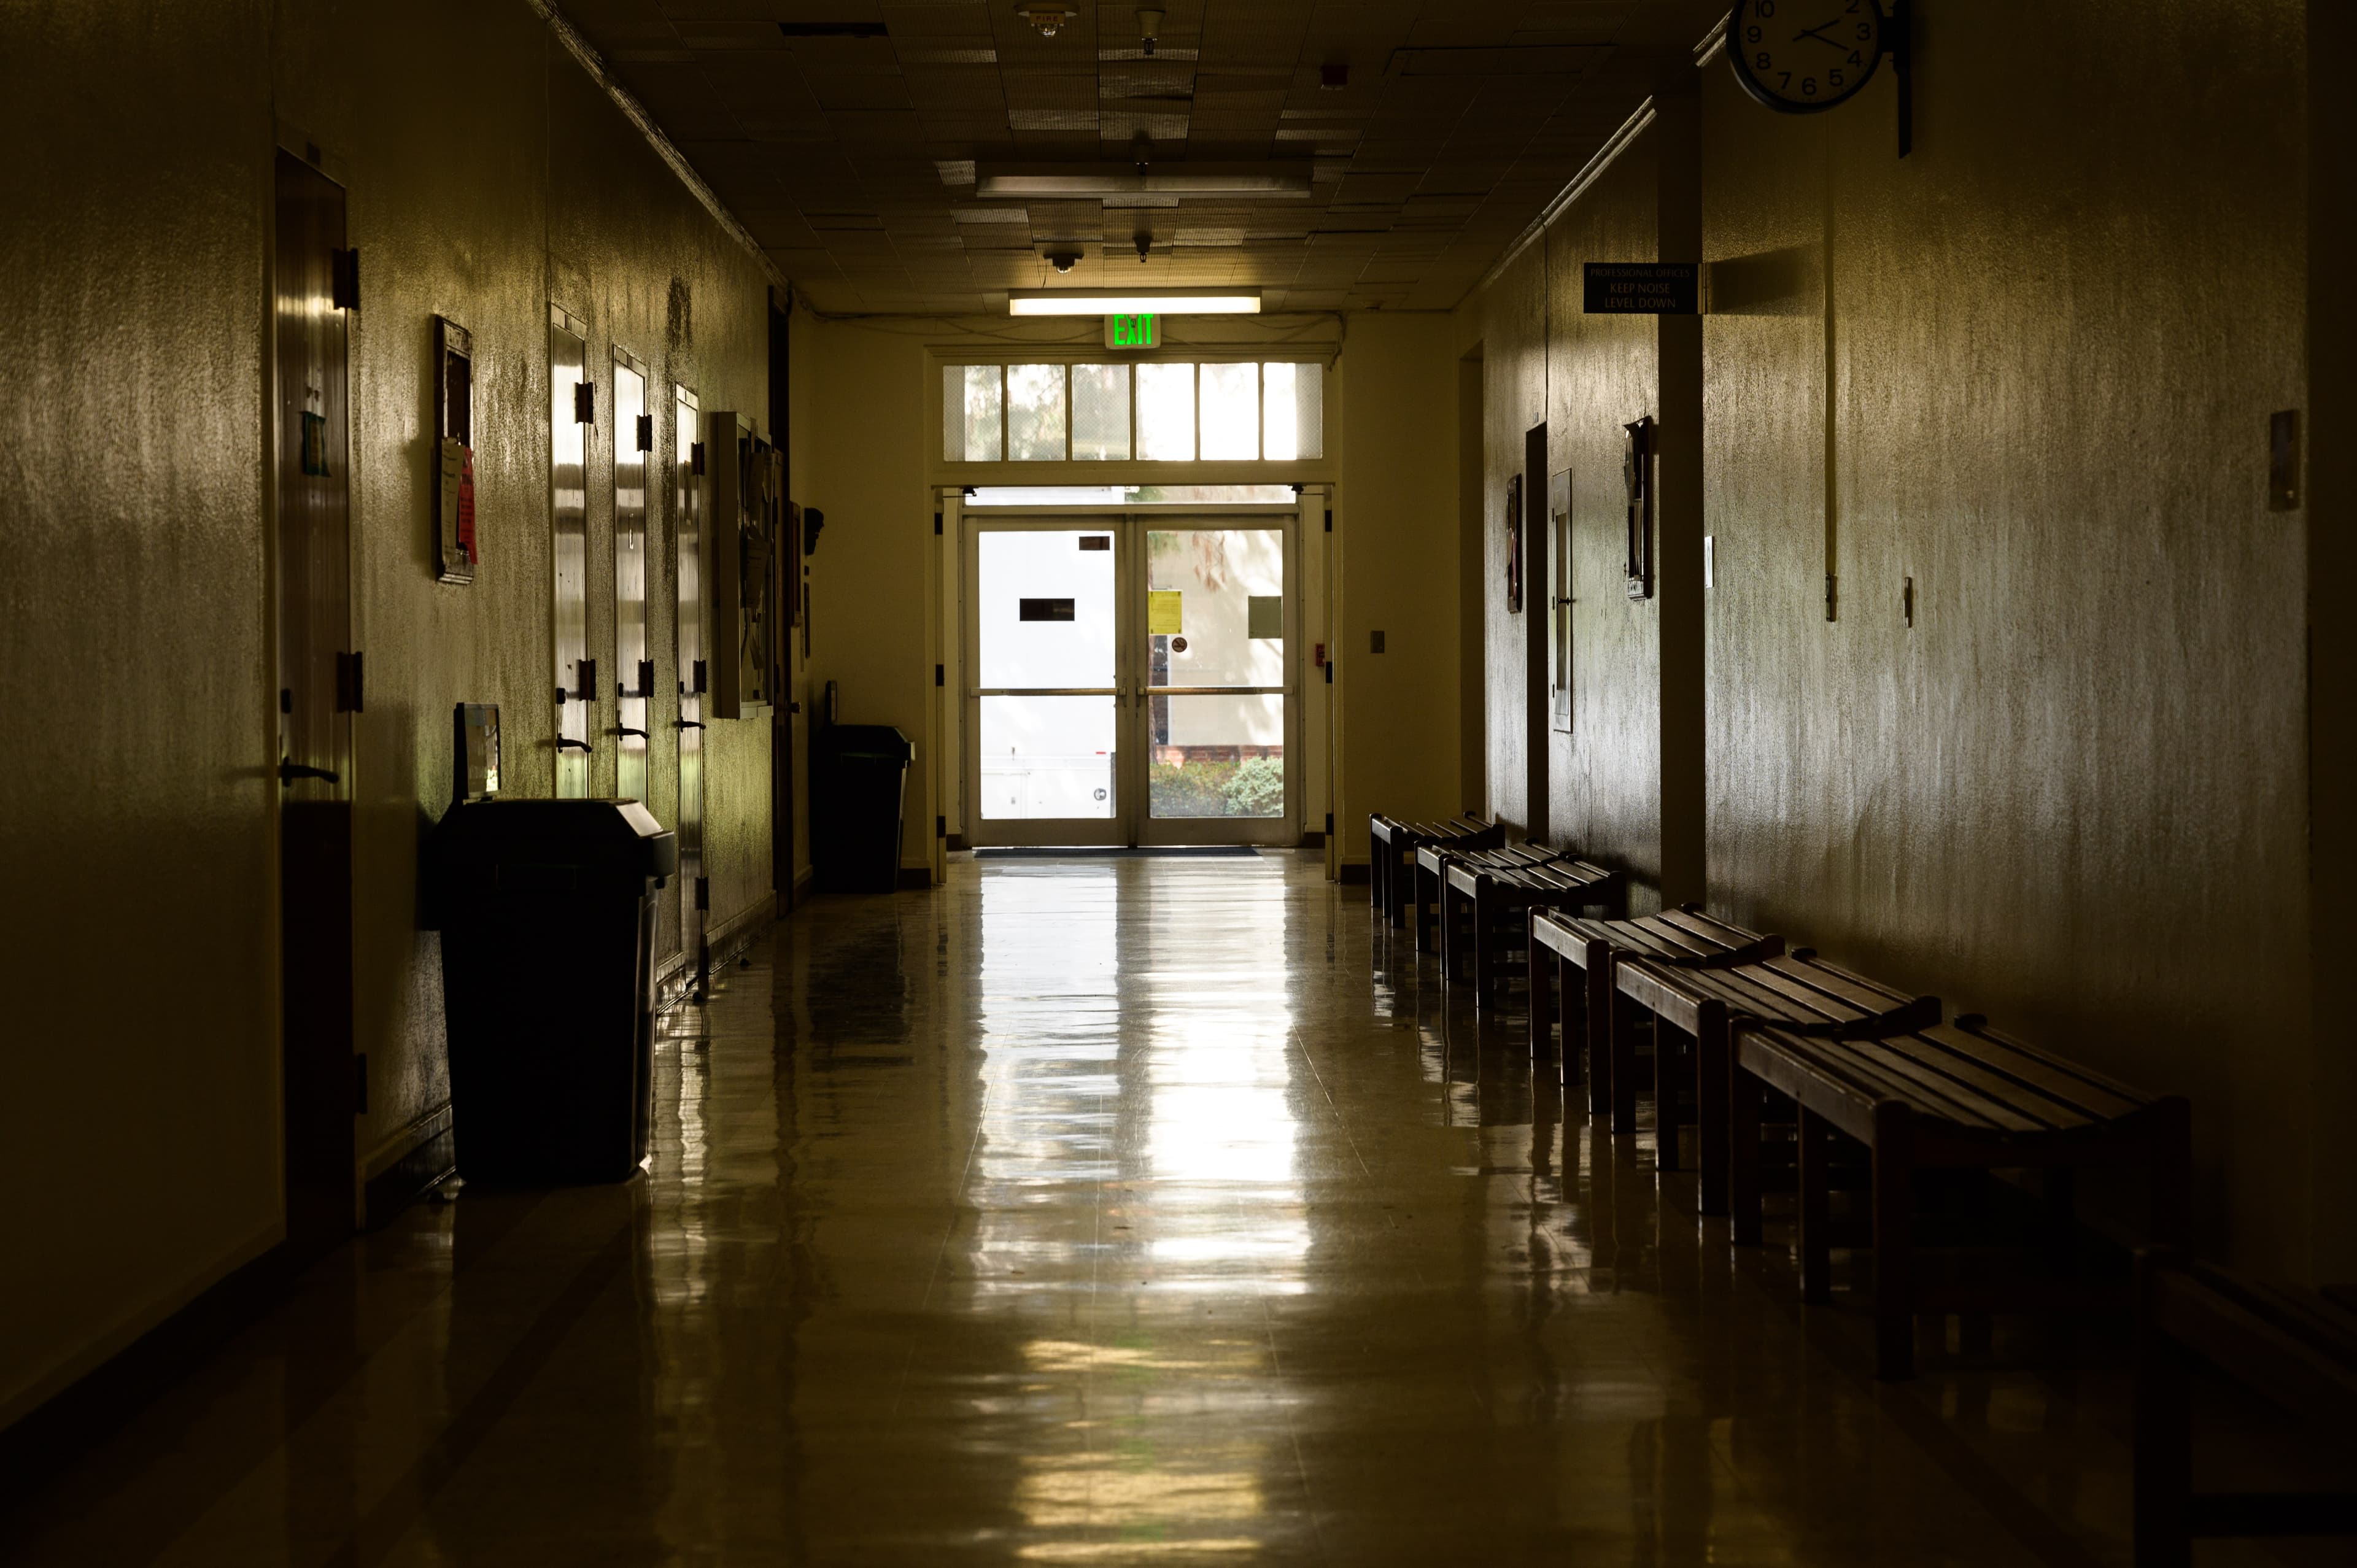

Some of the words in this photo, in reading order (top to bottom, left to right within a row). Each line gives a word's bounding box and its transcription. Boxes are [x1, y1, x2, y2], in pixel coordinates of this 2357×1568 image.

[1755, 0, 1775, 18] 10
[1846, 0, 1860, 13] 2
[1747, 26, 1762, 43] 9
[1856, 22, 1871, 41] 3
[1756, 52, 1771, 70] 8
[1847, 50, 1862, 68] 4
[1777, 72, 1792, 90] 7
[1802, 77, 1816, 95] 6
[1829, 69, 1844, 87] 5
[1590, 268, 1654, 277] PROFESSIONAL
[1656, 268, 1690, 277] OFFICES
[1610, 282, 1635, 294] KEEP
[1638, 282, 1670, 294] NOISE
[1604, 297, 1635, 308] LEVEL
[1638, 297, 1676, 308] DOWN
[1114, 314, 1154, 345] EXIT
